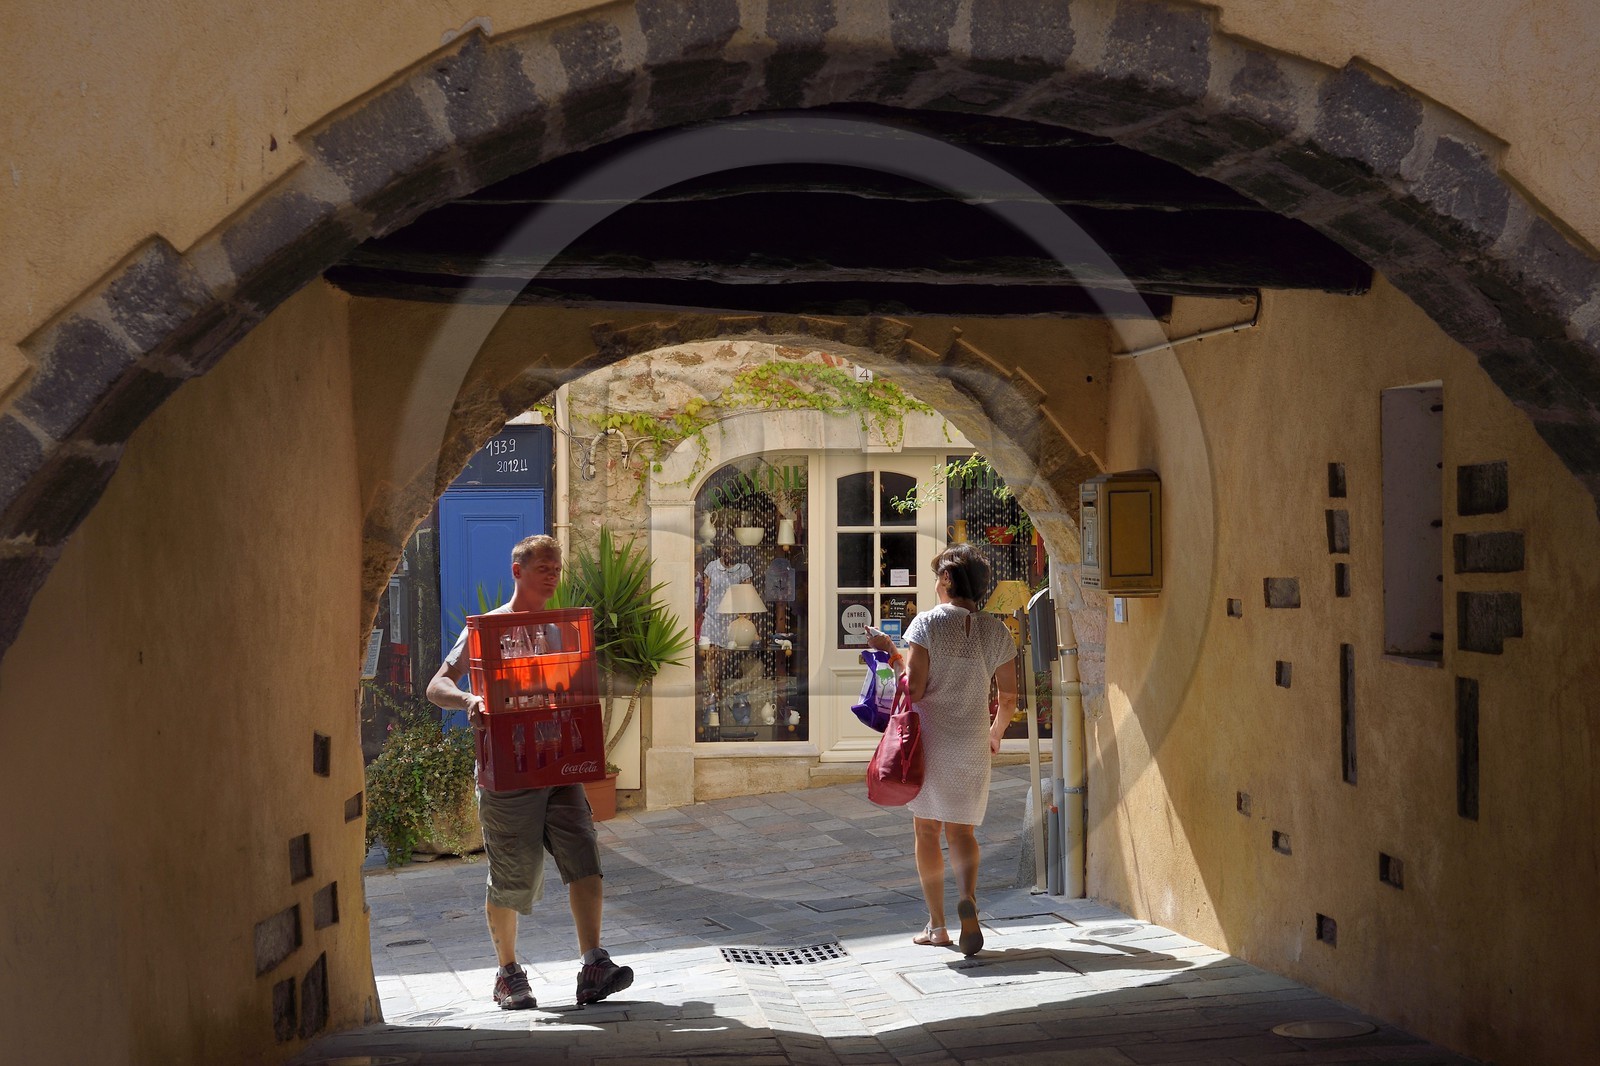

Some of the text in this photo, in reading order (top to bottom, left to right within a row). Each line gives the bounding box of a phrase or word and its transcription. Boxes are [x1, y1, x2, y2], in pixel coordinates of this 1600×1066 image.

[859, 368, 869, 380] 4
[486, 438, 515, 456] 1939
[561, 761, 597, 775] Coca-Cola
